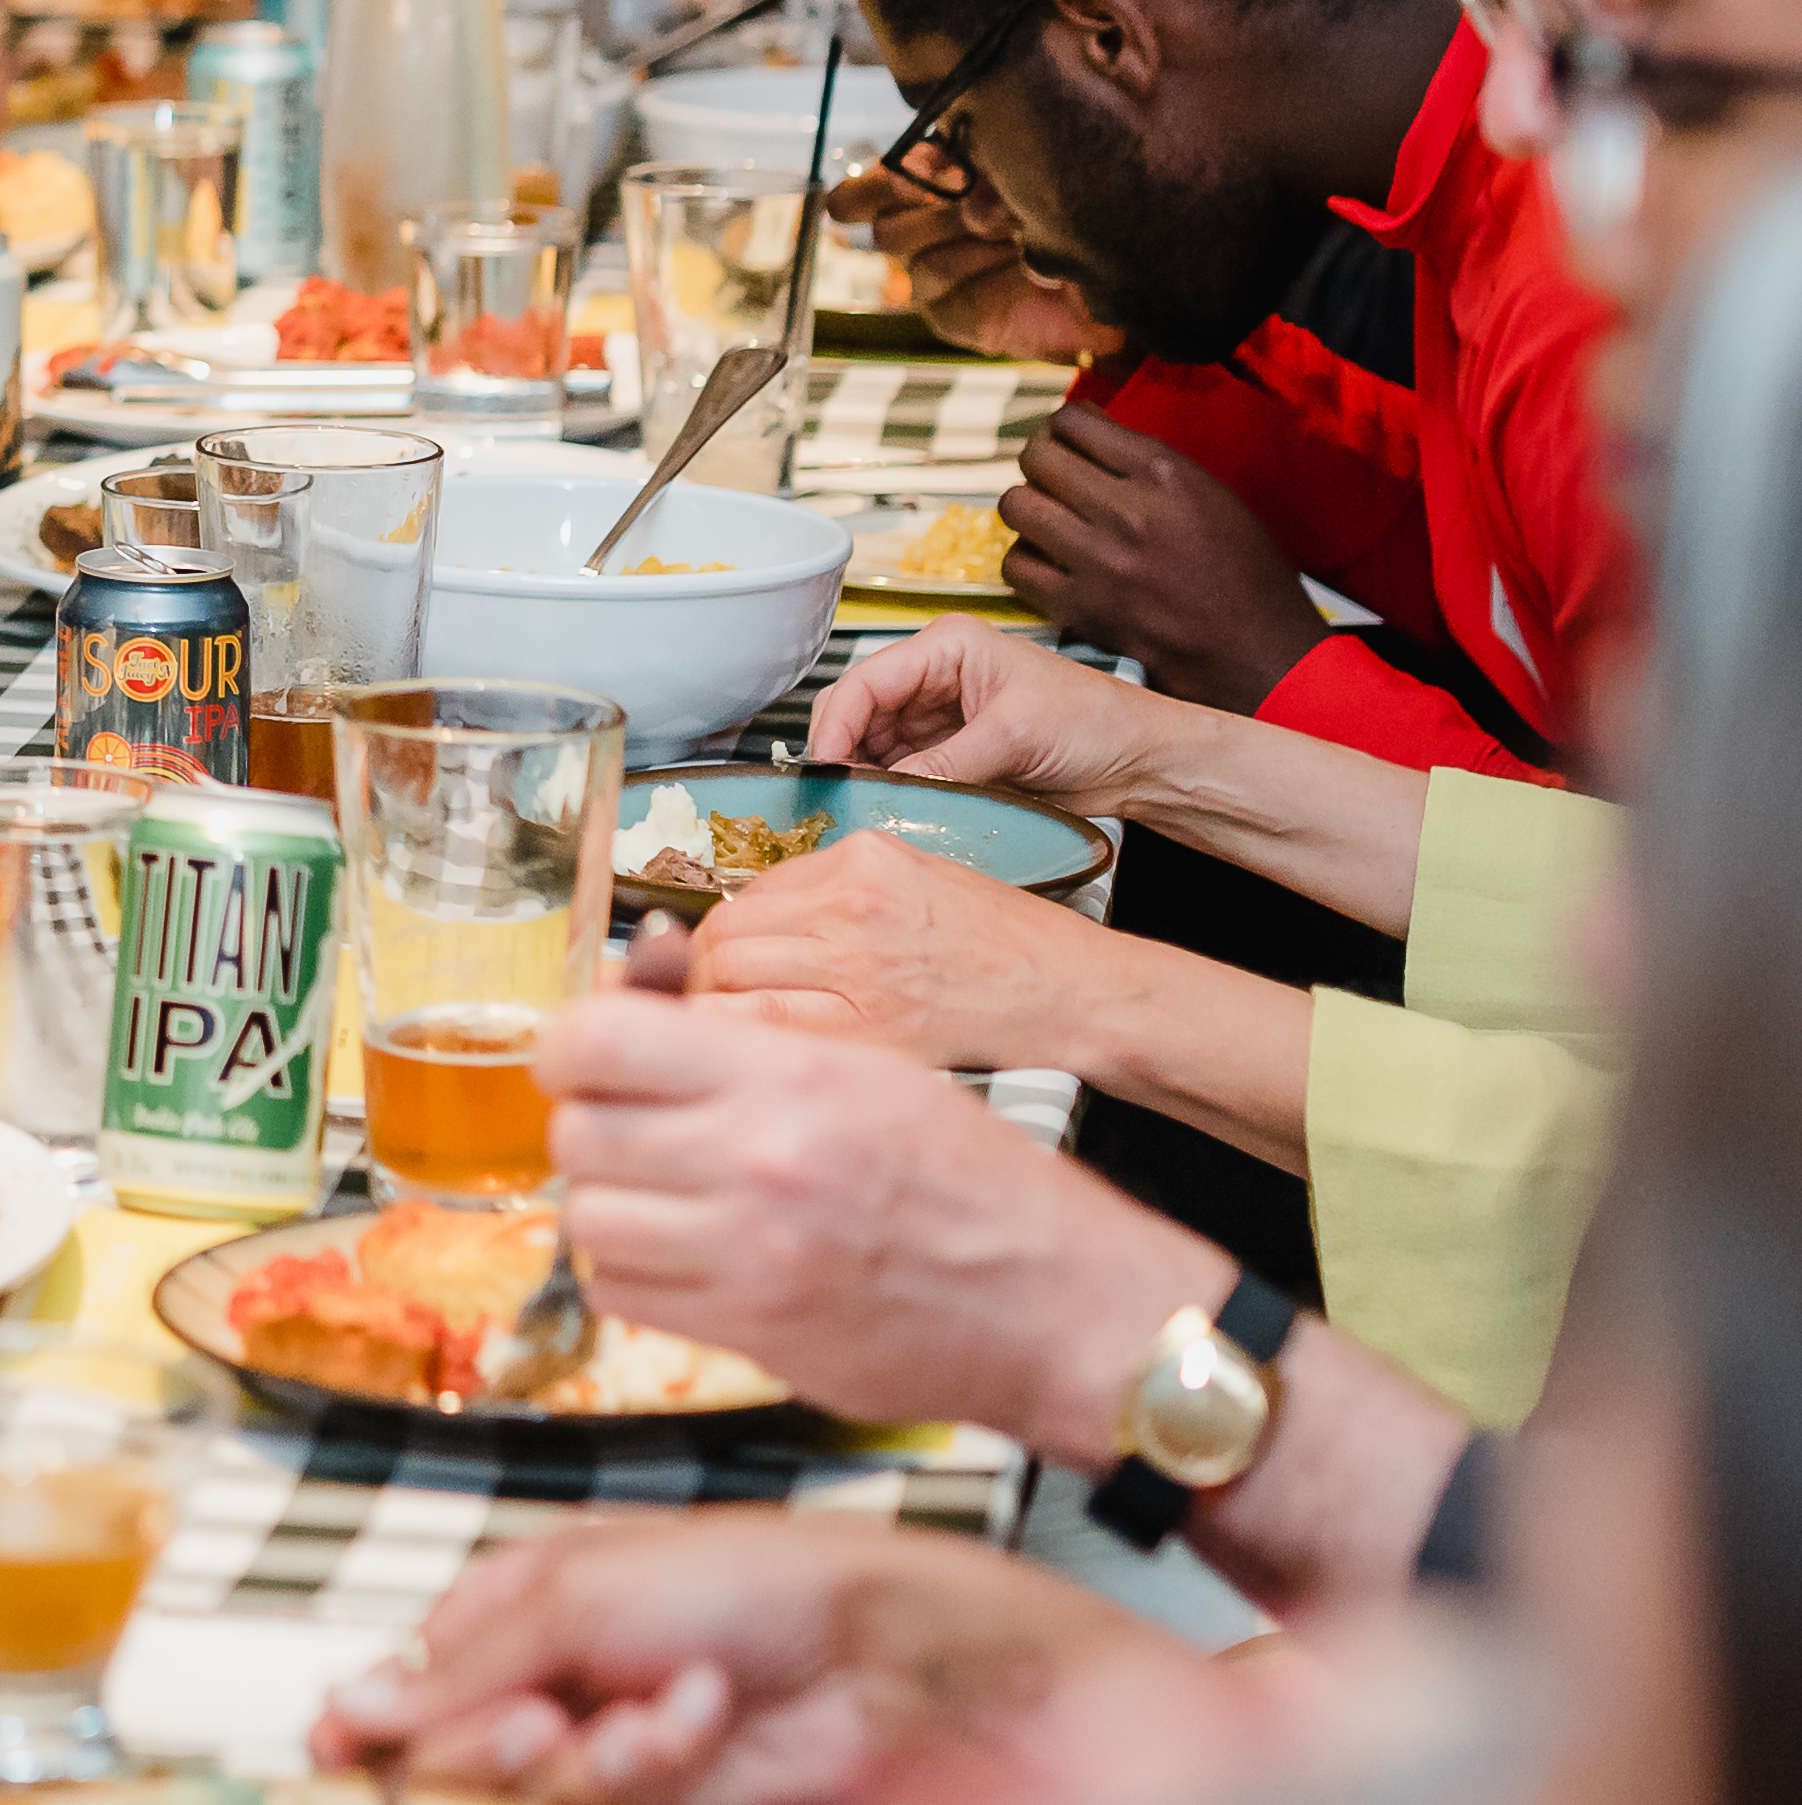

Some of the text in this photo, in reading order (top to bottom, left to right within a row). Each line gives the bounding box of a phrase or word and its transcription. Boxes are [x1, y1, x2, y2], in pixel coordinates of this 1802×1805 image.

[82, 633, 242, 703] SOUR
[183, 702, 242, 744] IPA
[134, 851, 308, 1000] TITAN
[124, 994, 292, 1096] IPA
